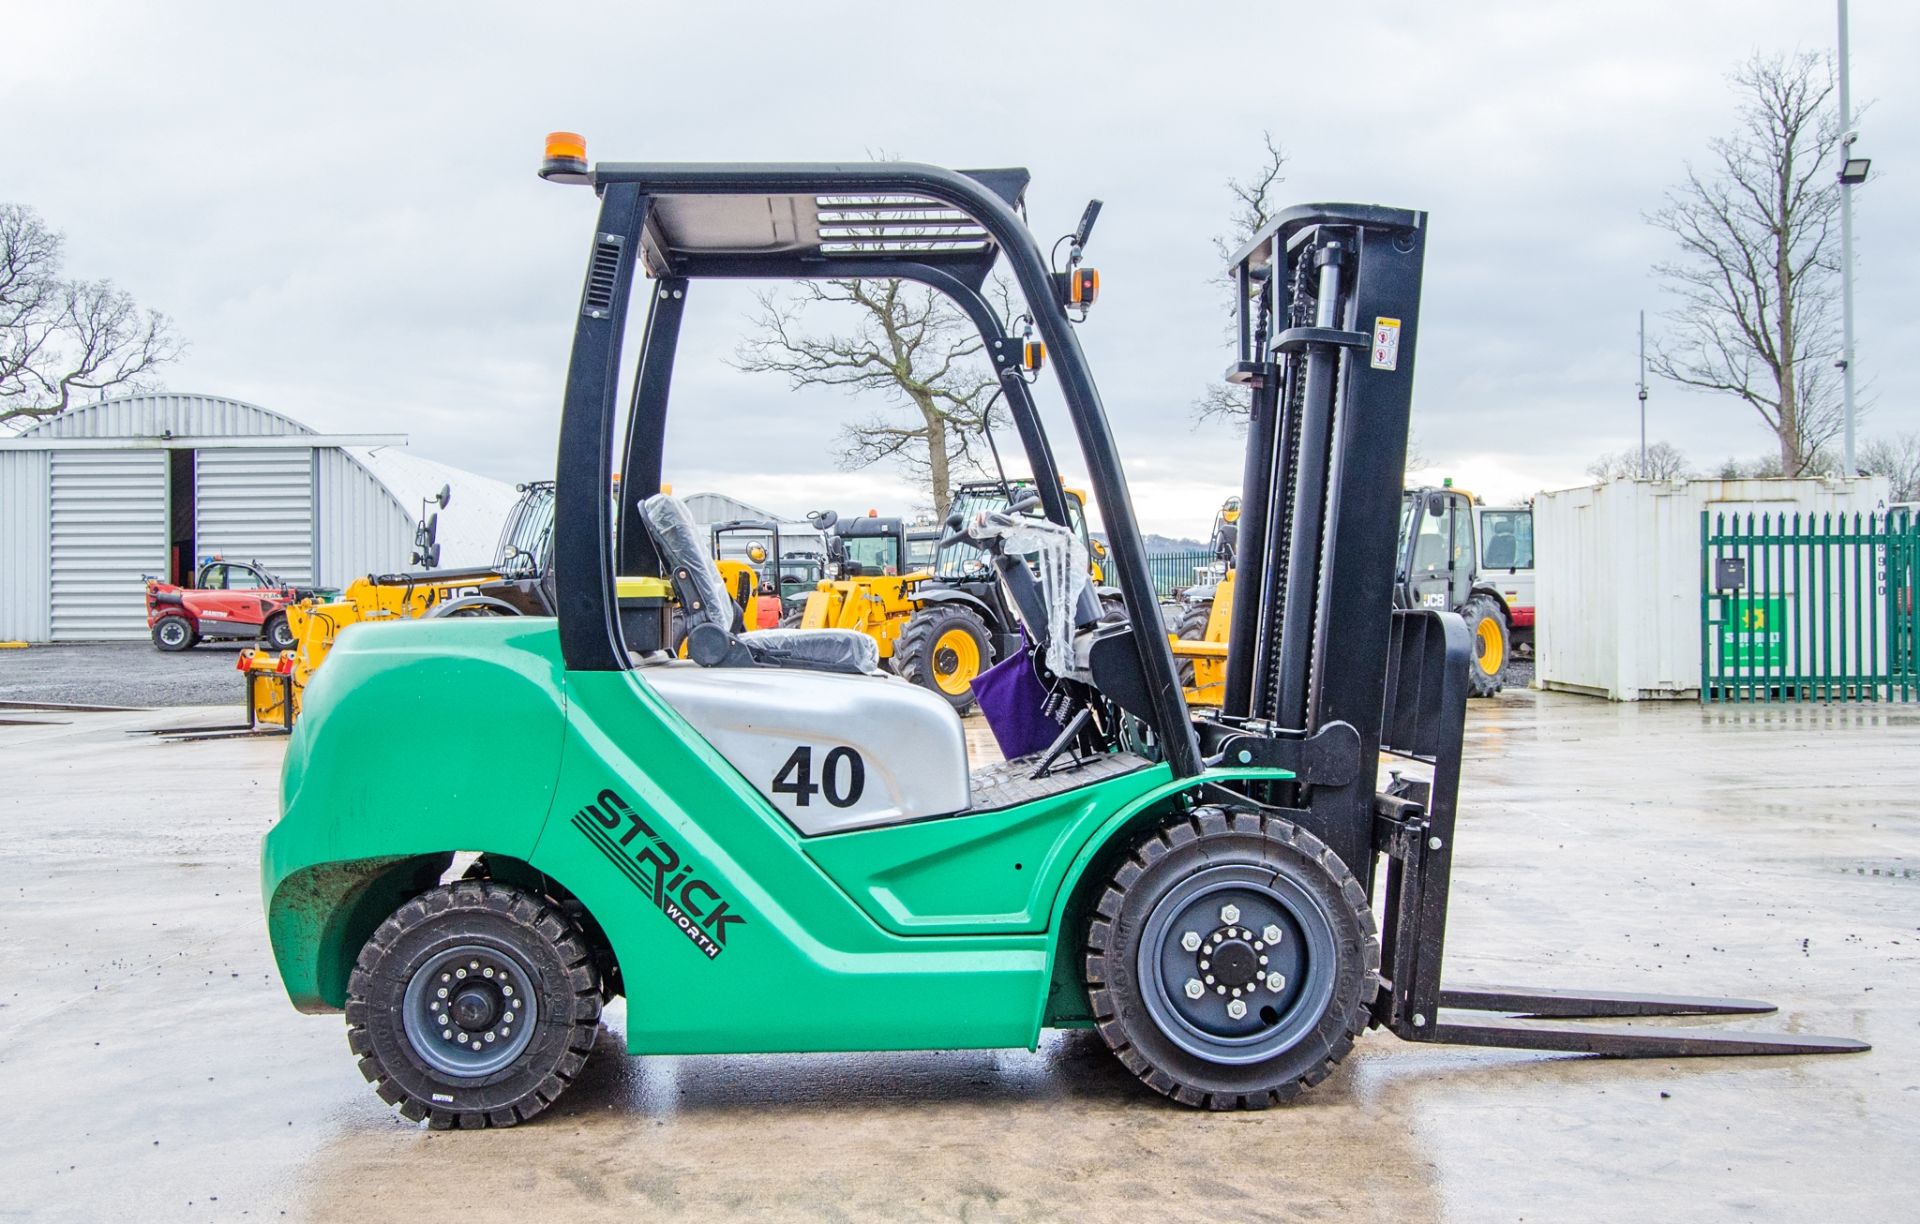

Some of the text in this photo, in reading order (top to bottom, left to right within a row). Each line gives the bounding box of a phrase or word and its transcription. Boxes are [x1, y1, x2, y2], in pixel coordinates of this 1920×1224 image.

[1423, 593, 1445, 607] JCB
[772, 746, 865, 808] 40
[666, 903, 719, 957] WORTH
